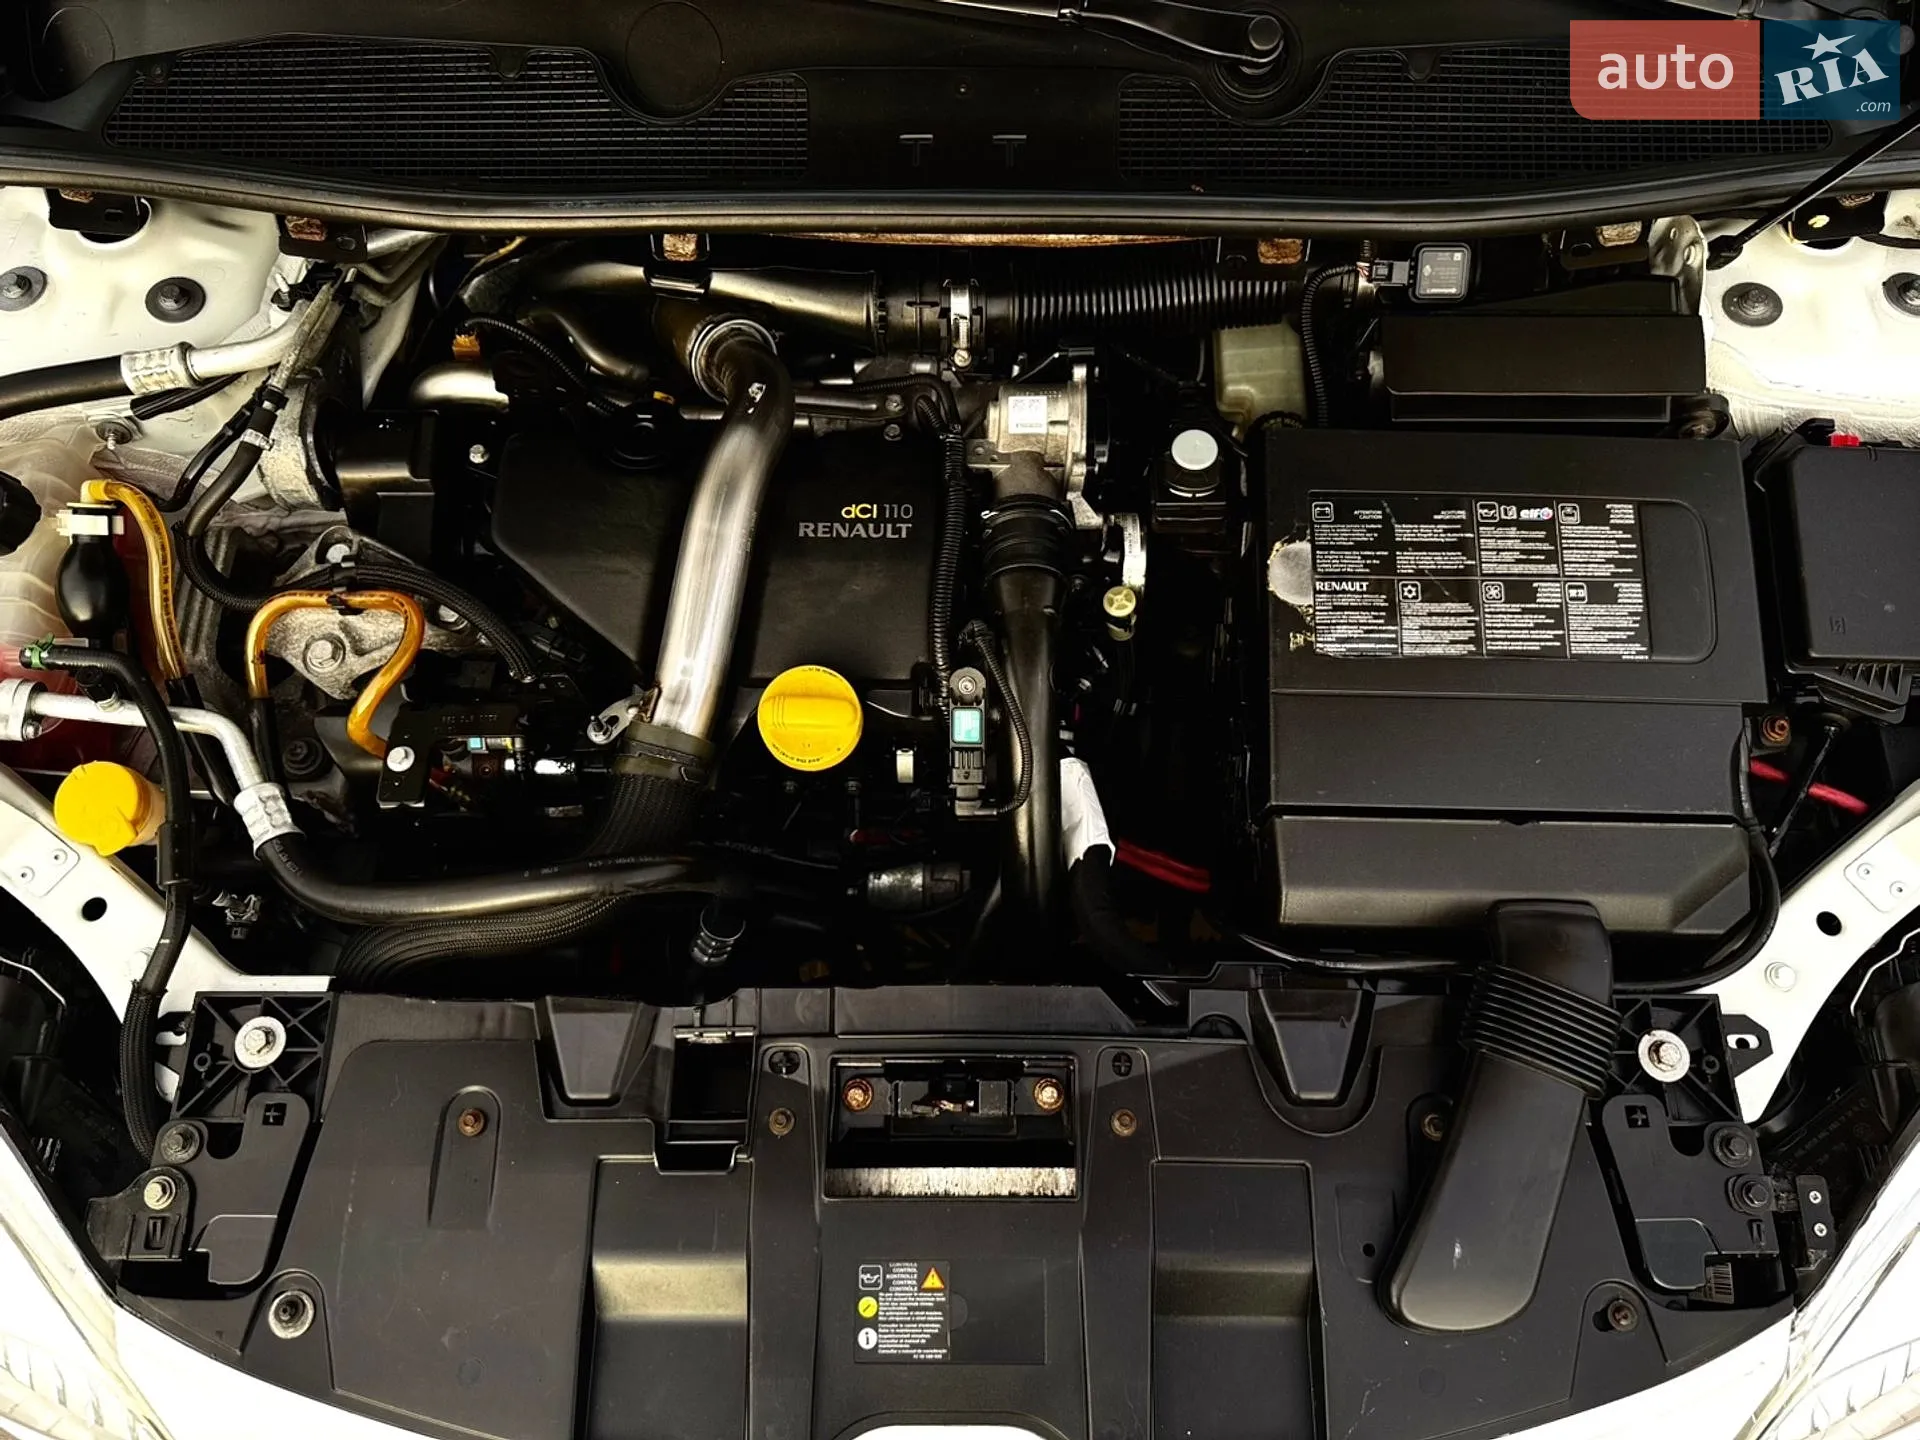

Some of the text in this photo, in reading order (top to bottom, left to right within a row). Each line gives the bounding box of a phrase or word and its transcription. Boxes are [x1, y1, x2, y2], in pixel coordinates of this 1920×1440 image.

[883, 503, 913, 519] 110
[798, 522, 913, 539] RENAULT
[1315, 581, 1369, 592] RENAULT
